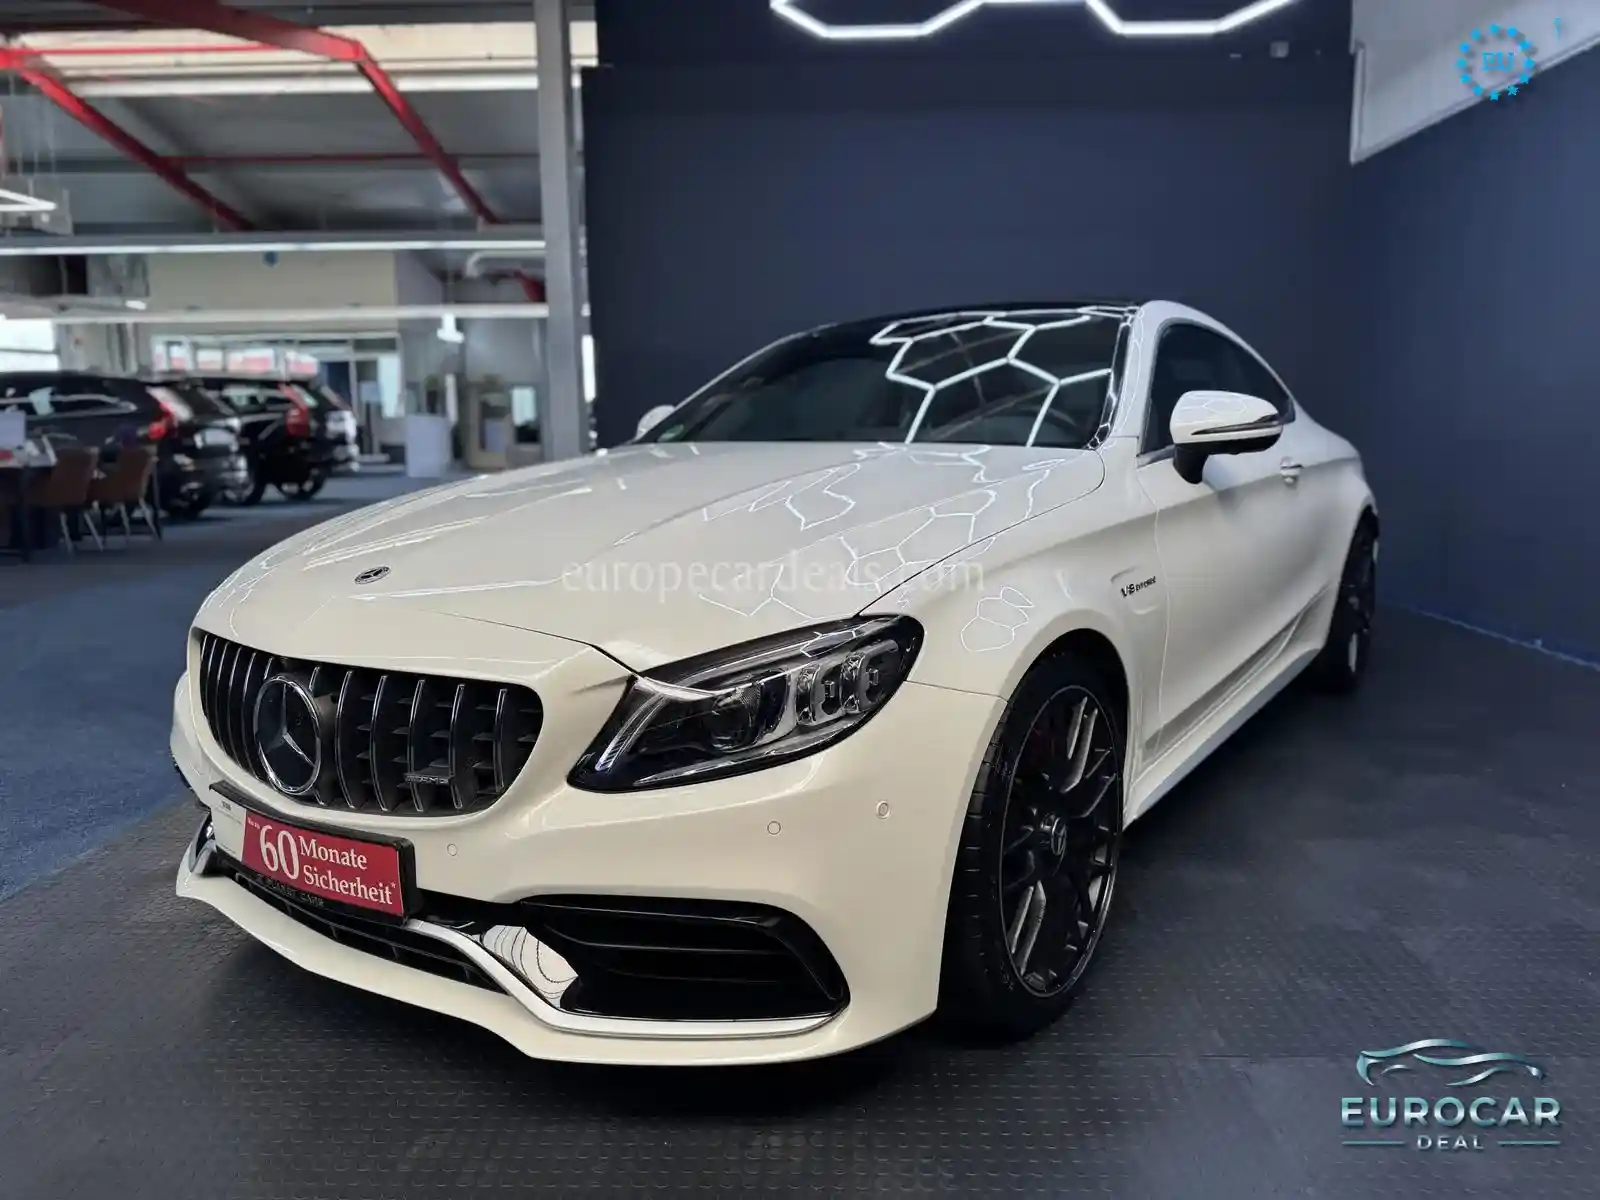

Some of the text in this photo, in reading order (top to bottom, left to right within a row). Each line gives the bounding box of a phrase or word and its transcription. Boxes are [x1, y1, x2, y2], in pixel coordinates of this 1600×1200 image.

[1120, 583, 1135, 598] V8
[259, 824, 368, 880] 60 Monate
